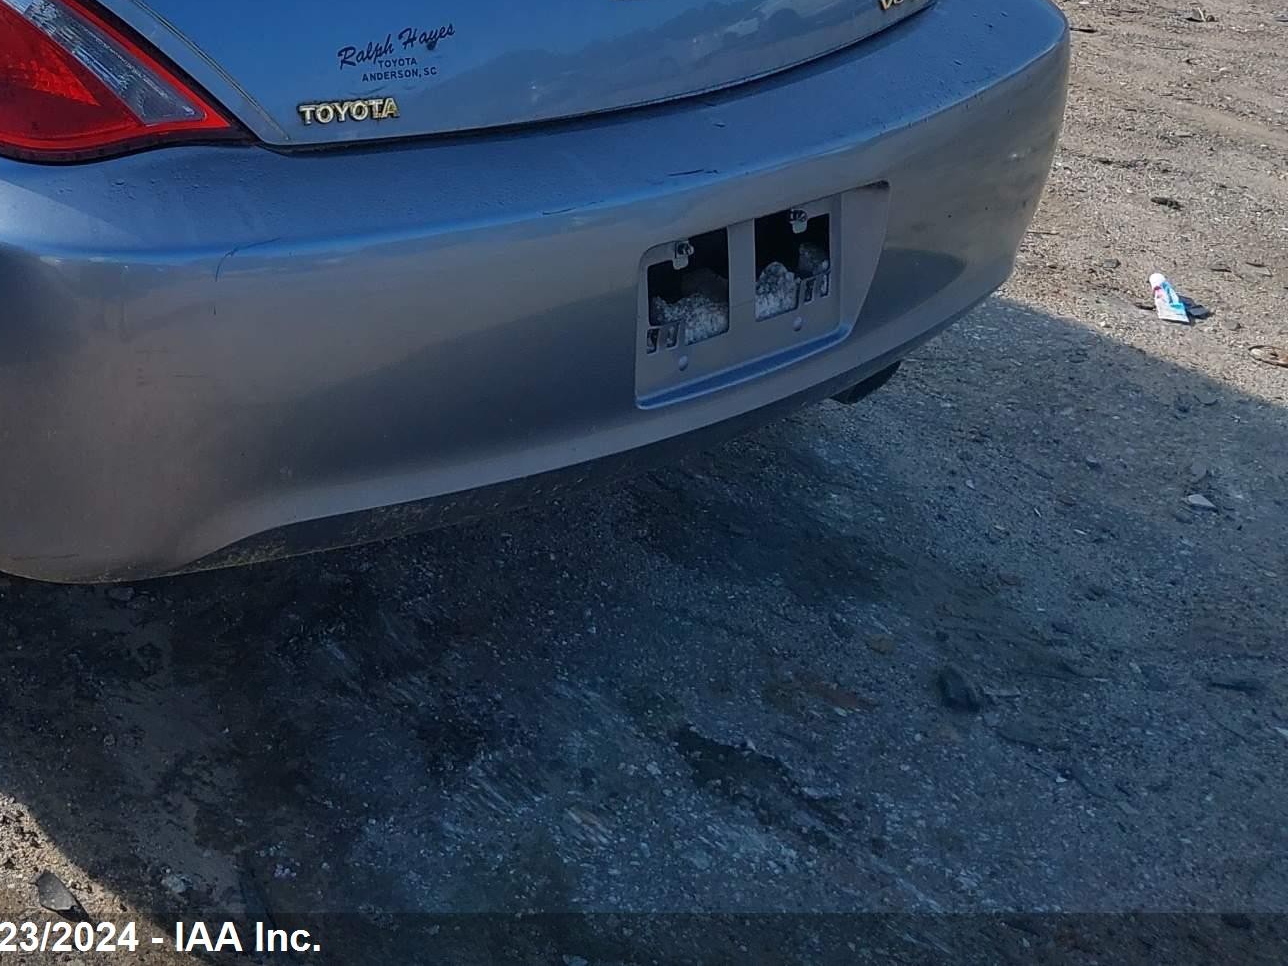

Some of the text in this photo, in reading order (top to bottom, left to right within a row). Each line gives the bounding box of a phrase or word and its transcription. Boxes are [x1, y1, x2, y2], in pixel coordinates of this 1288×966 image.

[337, 23, 456, 70] Ralph Hayes
[362, 66, 438, 82] ANDERSON, SC
[377, 57, 418, 69] TOYOTA
[298, 97, 400, 125] TOYOTA
